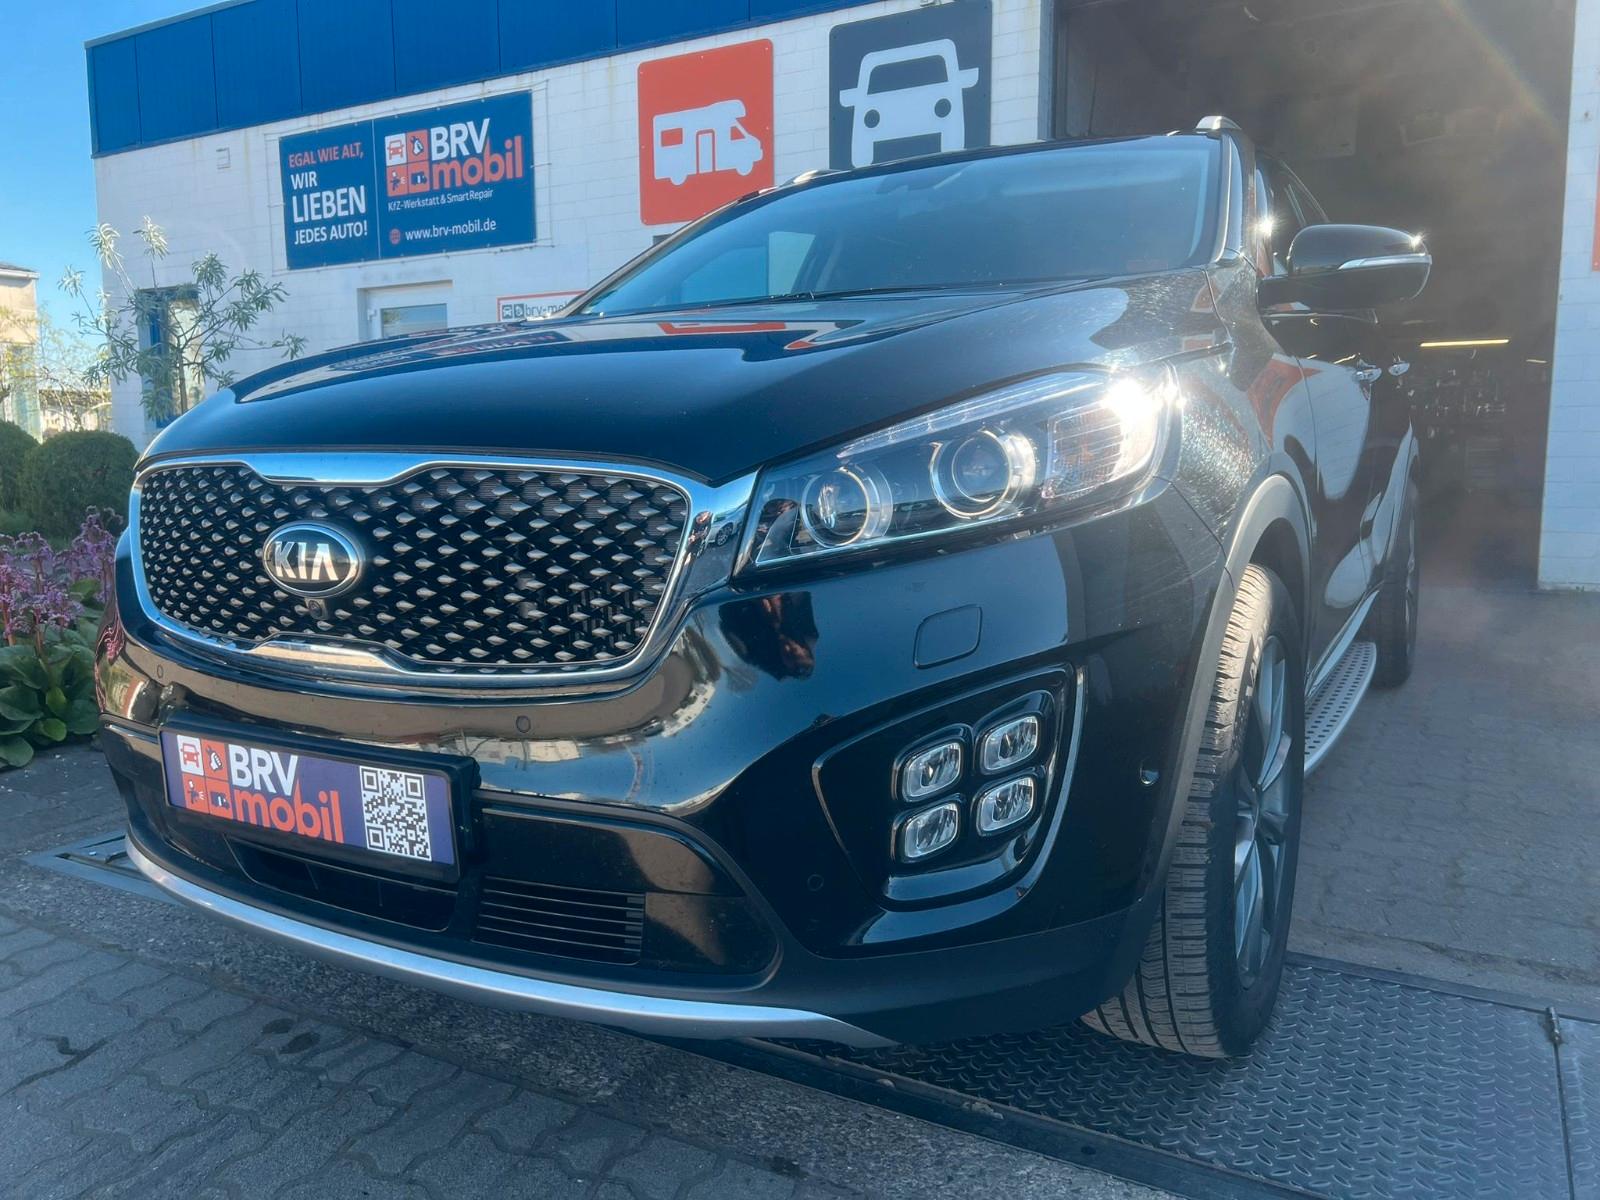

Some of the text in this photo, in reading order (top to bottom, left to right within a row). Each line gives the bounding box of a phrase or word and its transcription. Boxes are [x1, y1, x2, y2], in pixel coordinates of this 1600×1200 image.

[289, 143, 364, 167] EGAL WIE ALT,
[431, 118, 490, 161] BRV
[291, 171, 317, 189] WIR
[432, 136, 523, 190] mobil
[292, 185, 366, 223] LIEBEN
[388, 195, 440, 211] KfZ-Werkstatt
[440, 195, 446, 204] &
[294, 220, 367, 245] JEDES AUTO!
[406, 218, 496, 241] www.brv-mobil.de
[274, 541, 338, 580] KIA
[228, 744, 298, 796] BRV
[234, 779, 344, 843] mobil
